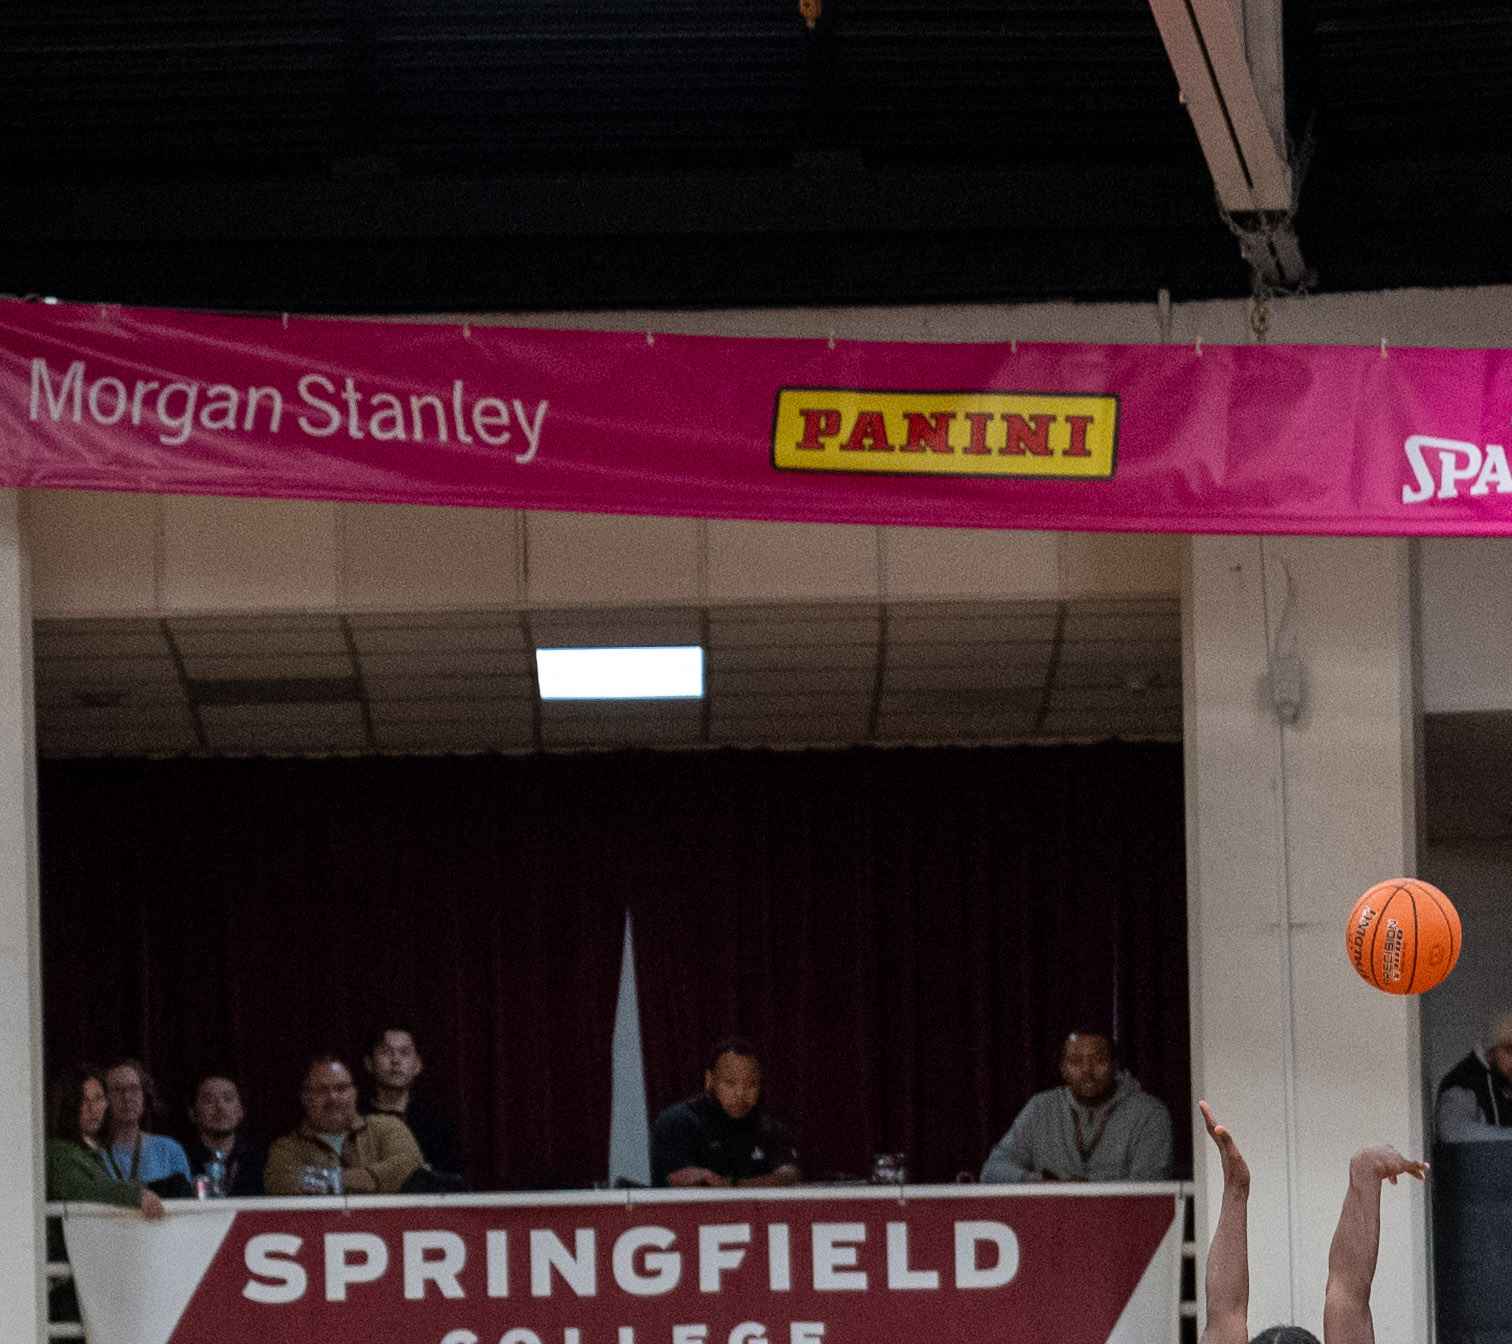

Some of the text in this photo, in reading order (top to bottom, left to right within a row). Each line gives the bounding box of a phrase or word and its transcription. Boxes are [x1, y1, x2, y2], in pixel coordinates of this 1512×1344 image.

[28, 358, 549, 463] Morgan Stanley
[794, 406, 1094, 459] PANINI
[241, 1219, 1022, 1305] SPRINGFIELD
